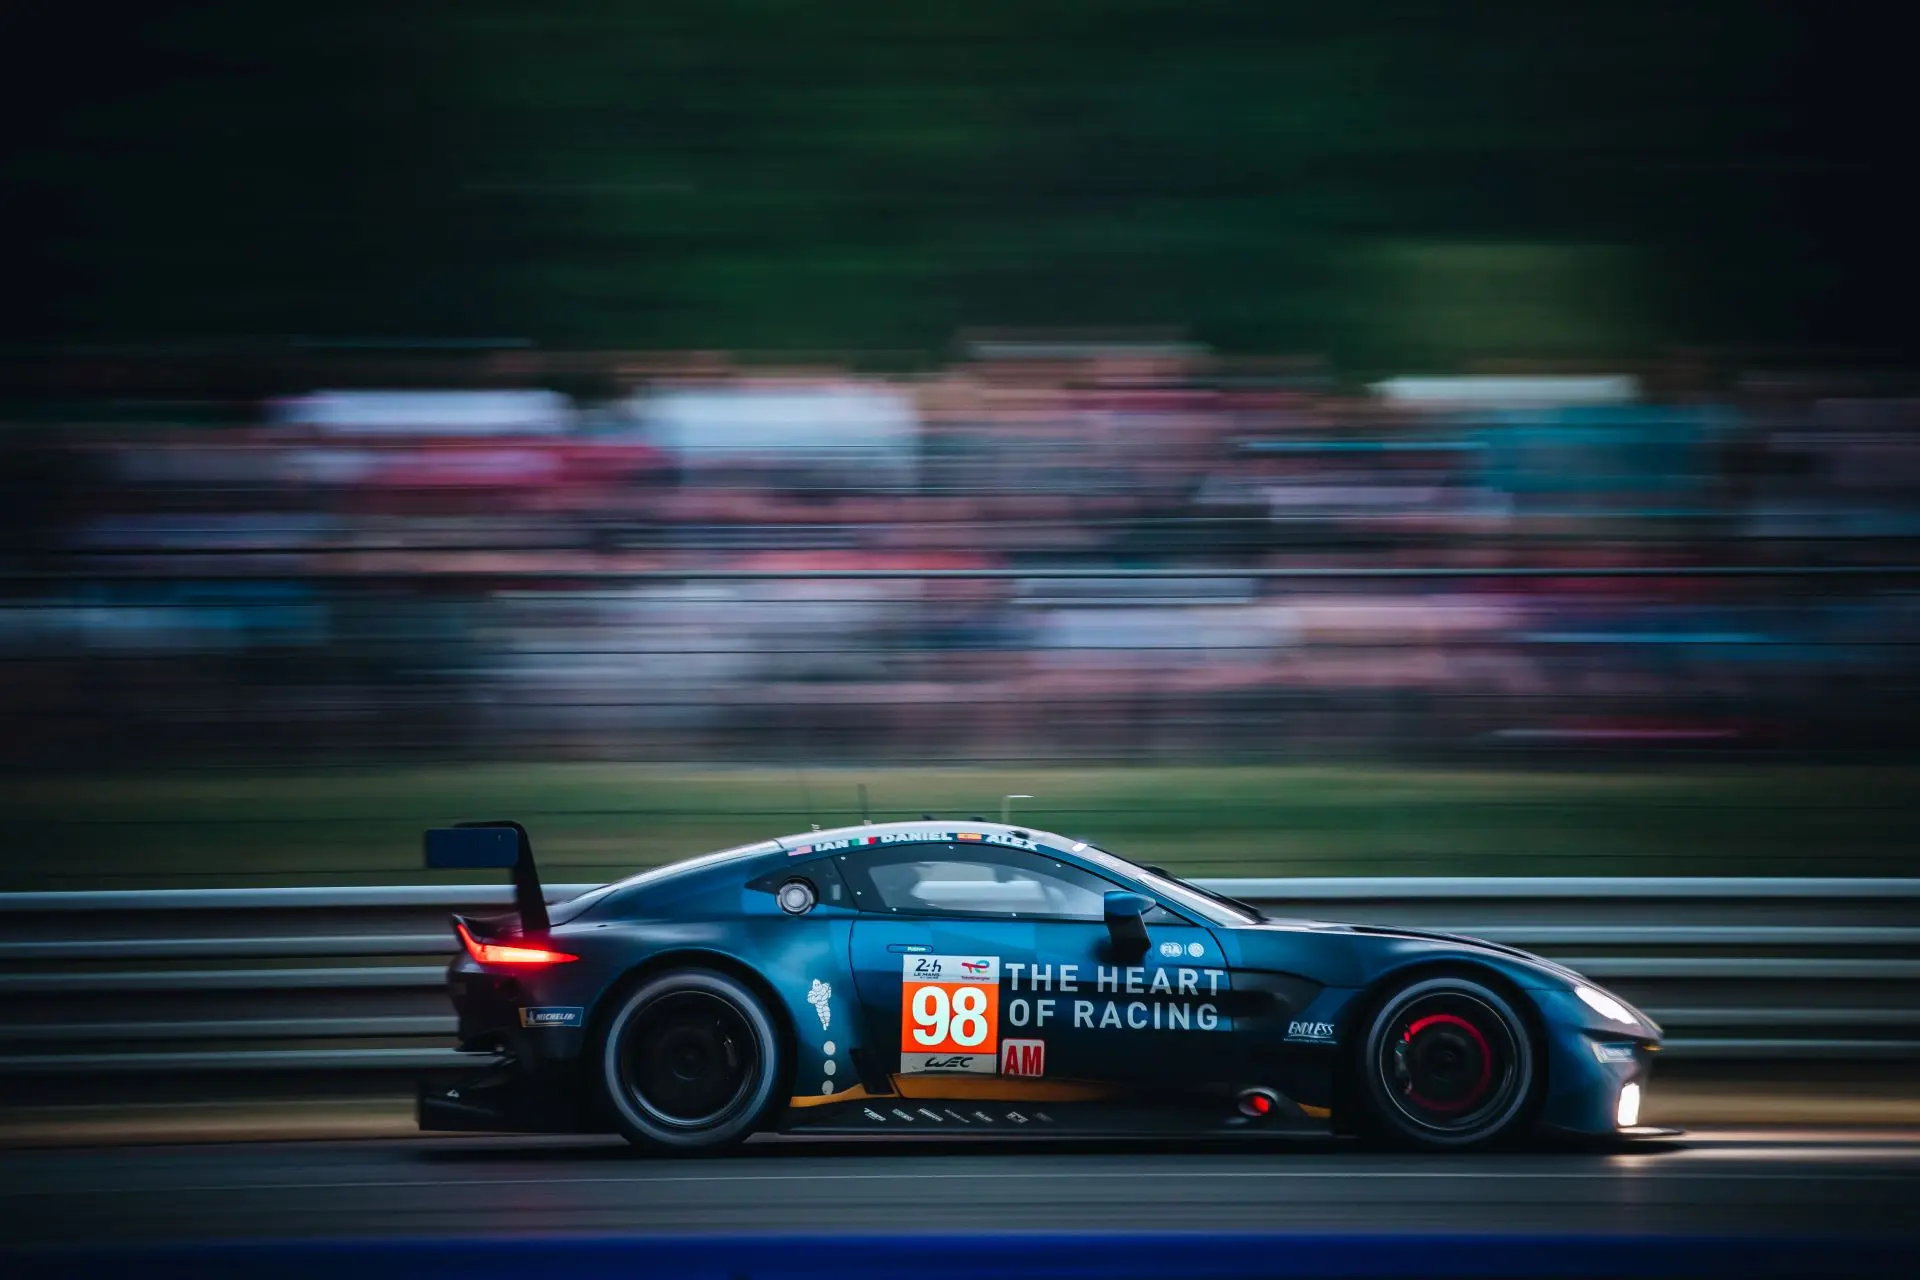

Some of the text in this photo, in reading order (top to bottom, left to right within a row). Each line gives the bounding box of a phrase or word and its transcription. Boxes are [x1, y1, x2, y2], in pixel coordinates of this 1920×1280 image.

[815, 832, 1038, 852] IAN DANIEL ALEX
[1005, 963, 1224, 996] THE HEART
[912, 985, 988, 1047] 98
[1009, 999, 1219, 1030] OF RACING
[1288, 1020, 1335, 1035] ENDLESS
[924, 1056, 974, 1068] WEC
[1004, 1045, 1042, 1075] AM
